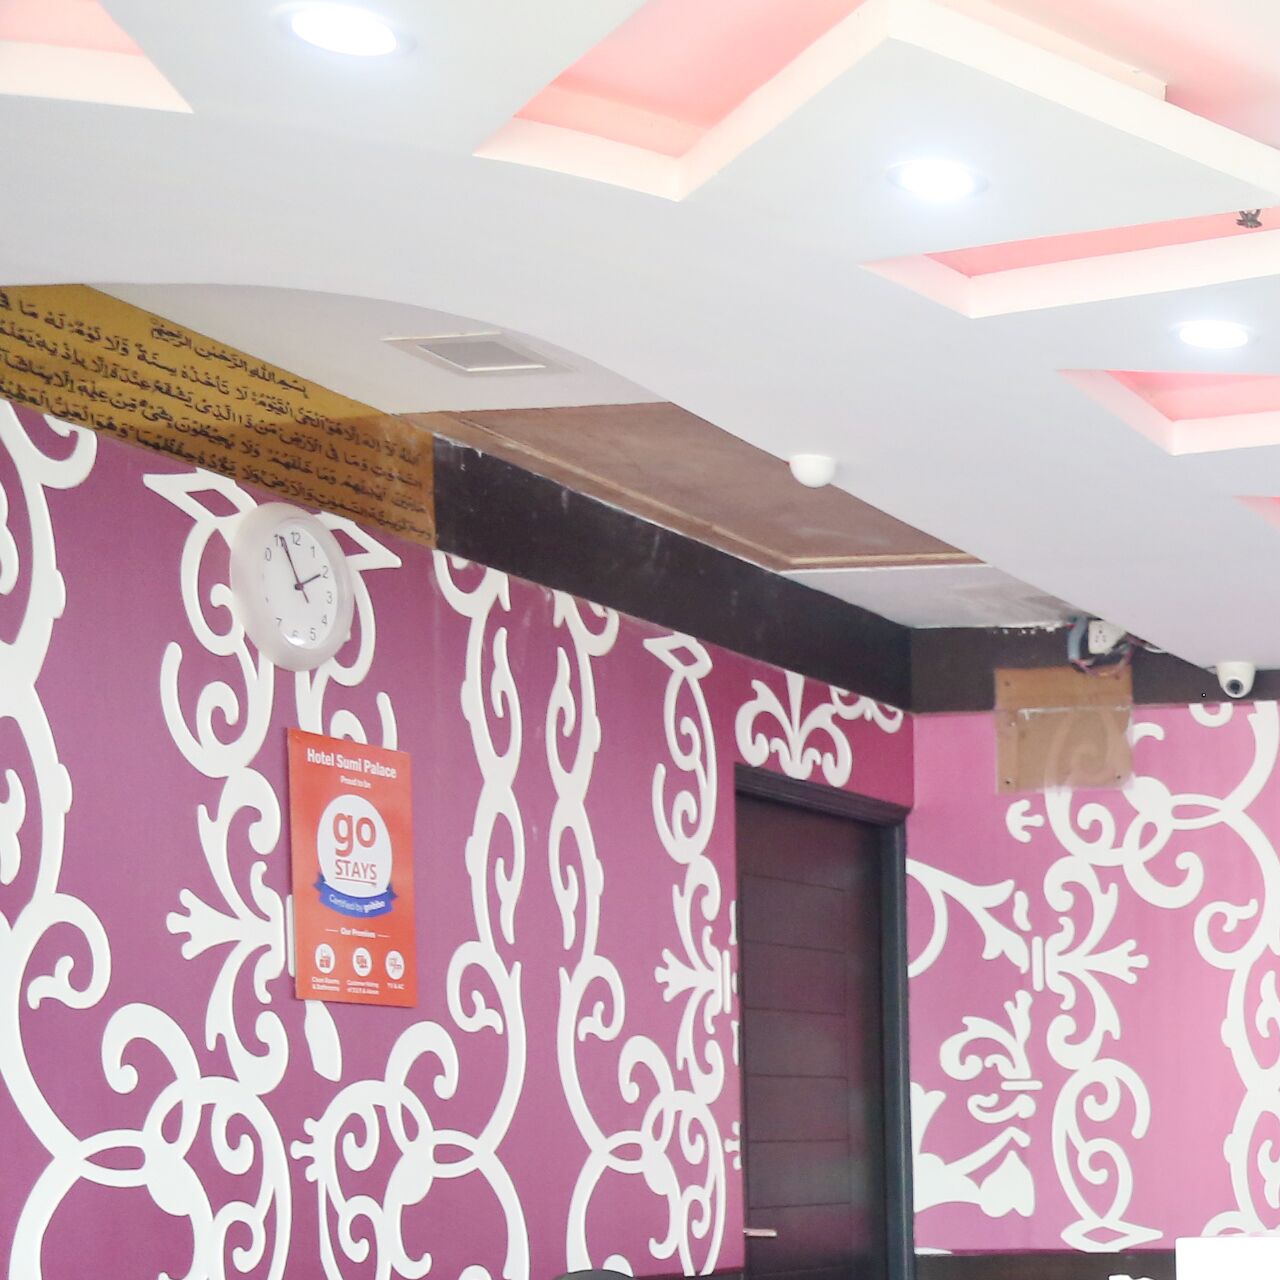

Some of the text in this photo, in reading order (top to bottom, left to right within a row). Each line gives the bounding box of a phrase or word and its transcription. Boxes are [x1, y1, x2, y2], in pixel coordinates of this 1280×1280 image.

[291, 532, 302, 546] 12
[322, 565, 329, 580] 2
[310, 627, 317, 641] 5
[307, 748, 397, 779] Hotel Sumi Palace
[333, 813, 376, 857] go
[335, 858, 377, 880] STAYS
